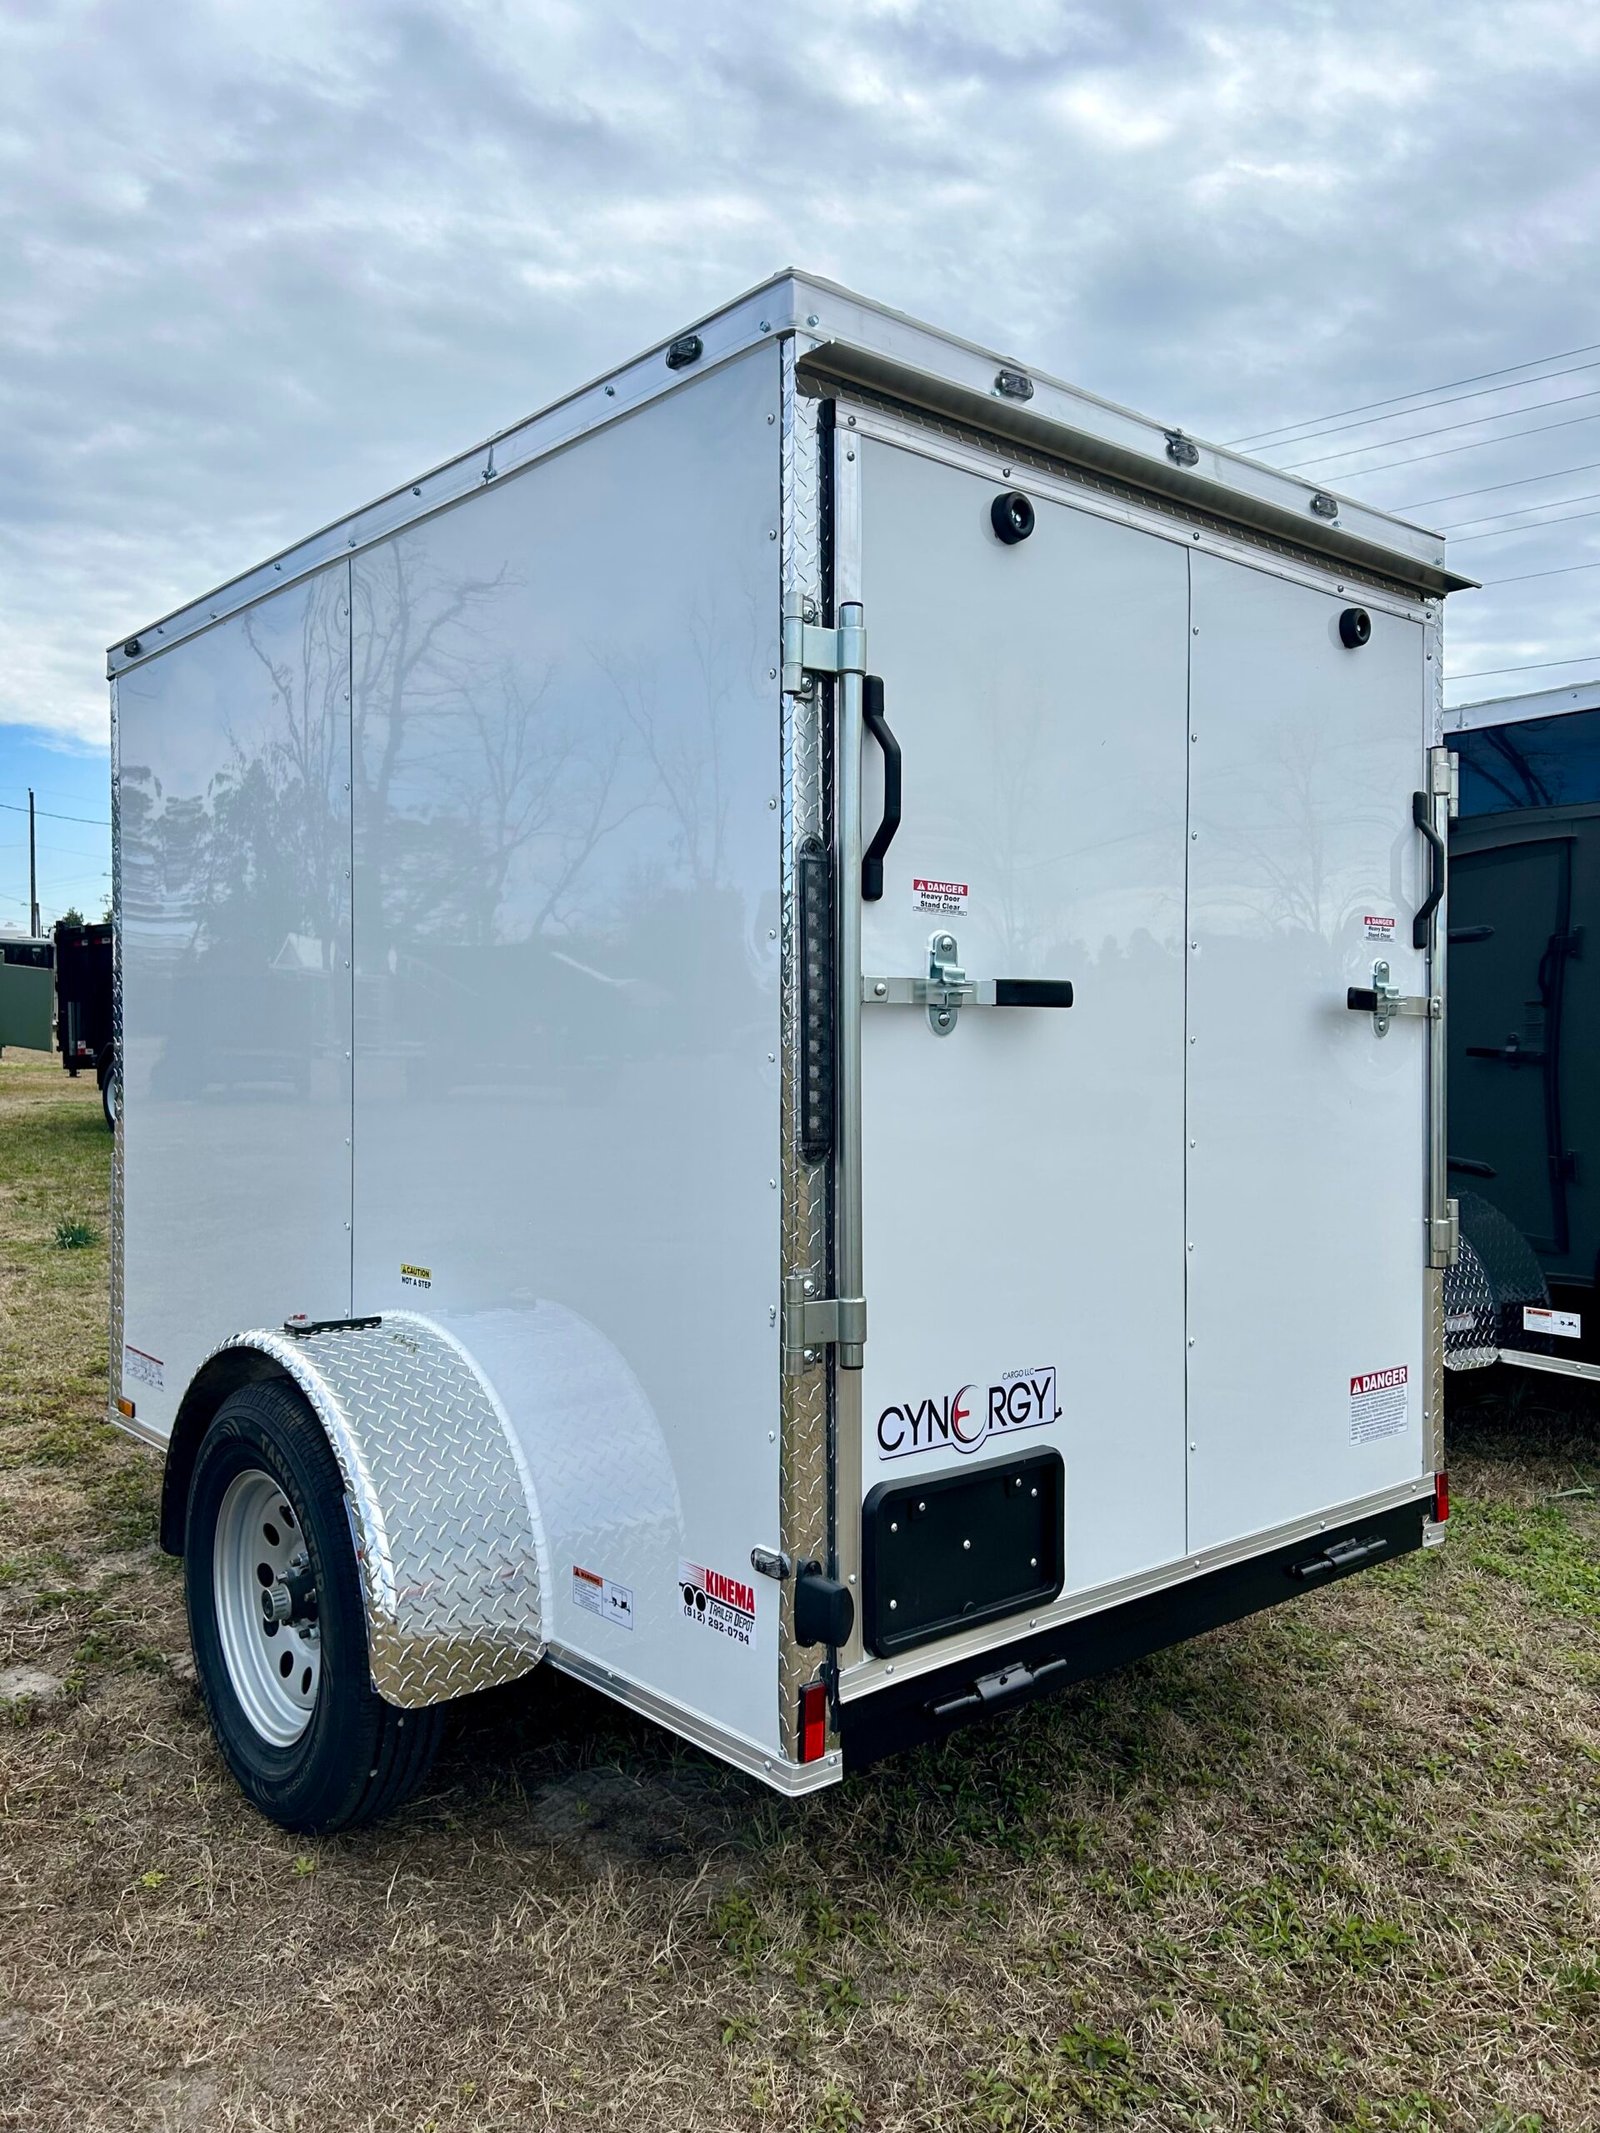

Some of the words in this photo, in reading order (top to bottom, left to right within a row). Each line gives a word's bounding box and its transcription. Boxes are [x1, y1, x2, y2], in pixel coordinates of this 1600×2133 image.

[927, 882, 965, 895] DANGER
[921, 892, 943, 902] Heavy
[944, 894, 960, 902] Door
[920, 900, 941, 909] Stand
[942, 902, 960, 911] Clear
[1371, 917, 1394, 926] DANGER
[407, 1266, 430, 1278] CAUTION
[401, 1276, 412, 1285] NOT
[418, 1279, 431, 1289] STEP
[1002, 1368, 1024, 1380] CARGO
[1024, 1367, 1035, 1377] LLC
[1363, 1367, 1406, 1392] DANGER
[877, 1376, 1052, 1451] CYNERGY
[705, 1568, 755, 1614] KINEMA
[709, 1601, 733, 1624] TRAILER
[733, 1614, 754, 1633] DEPOT
[684, 1605, 706, 1625] (912)
[708, 1617, 750, 1645] 292-0794
